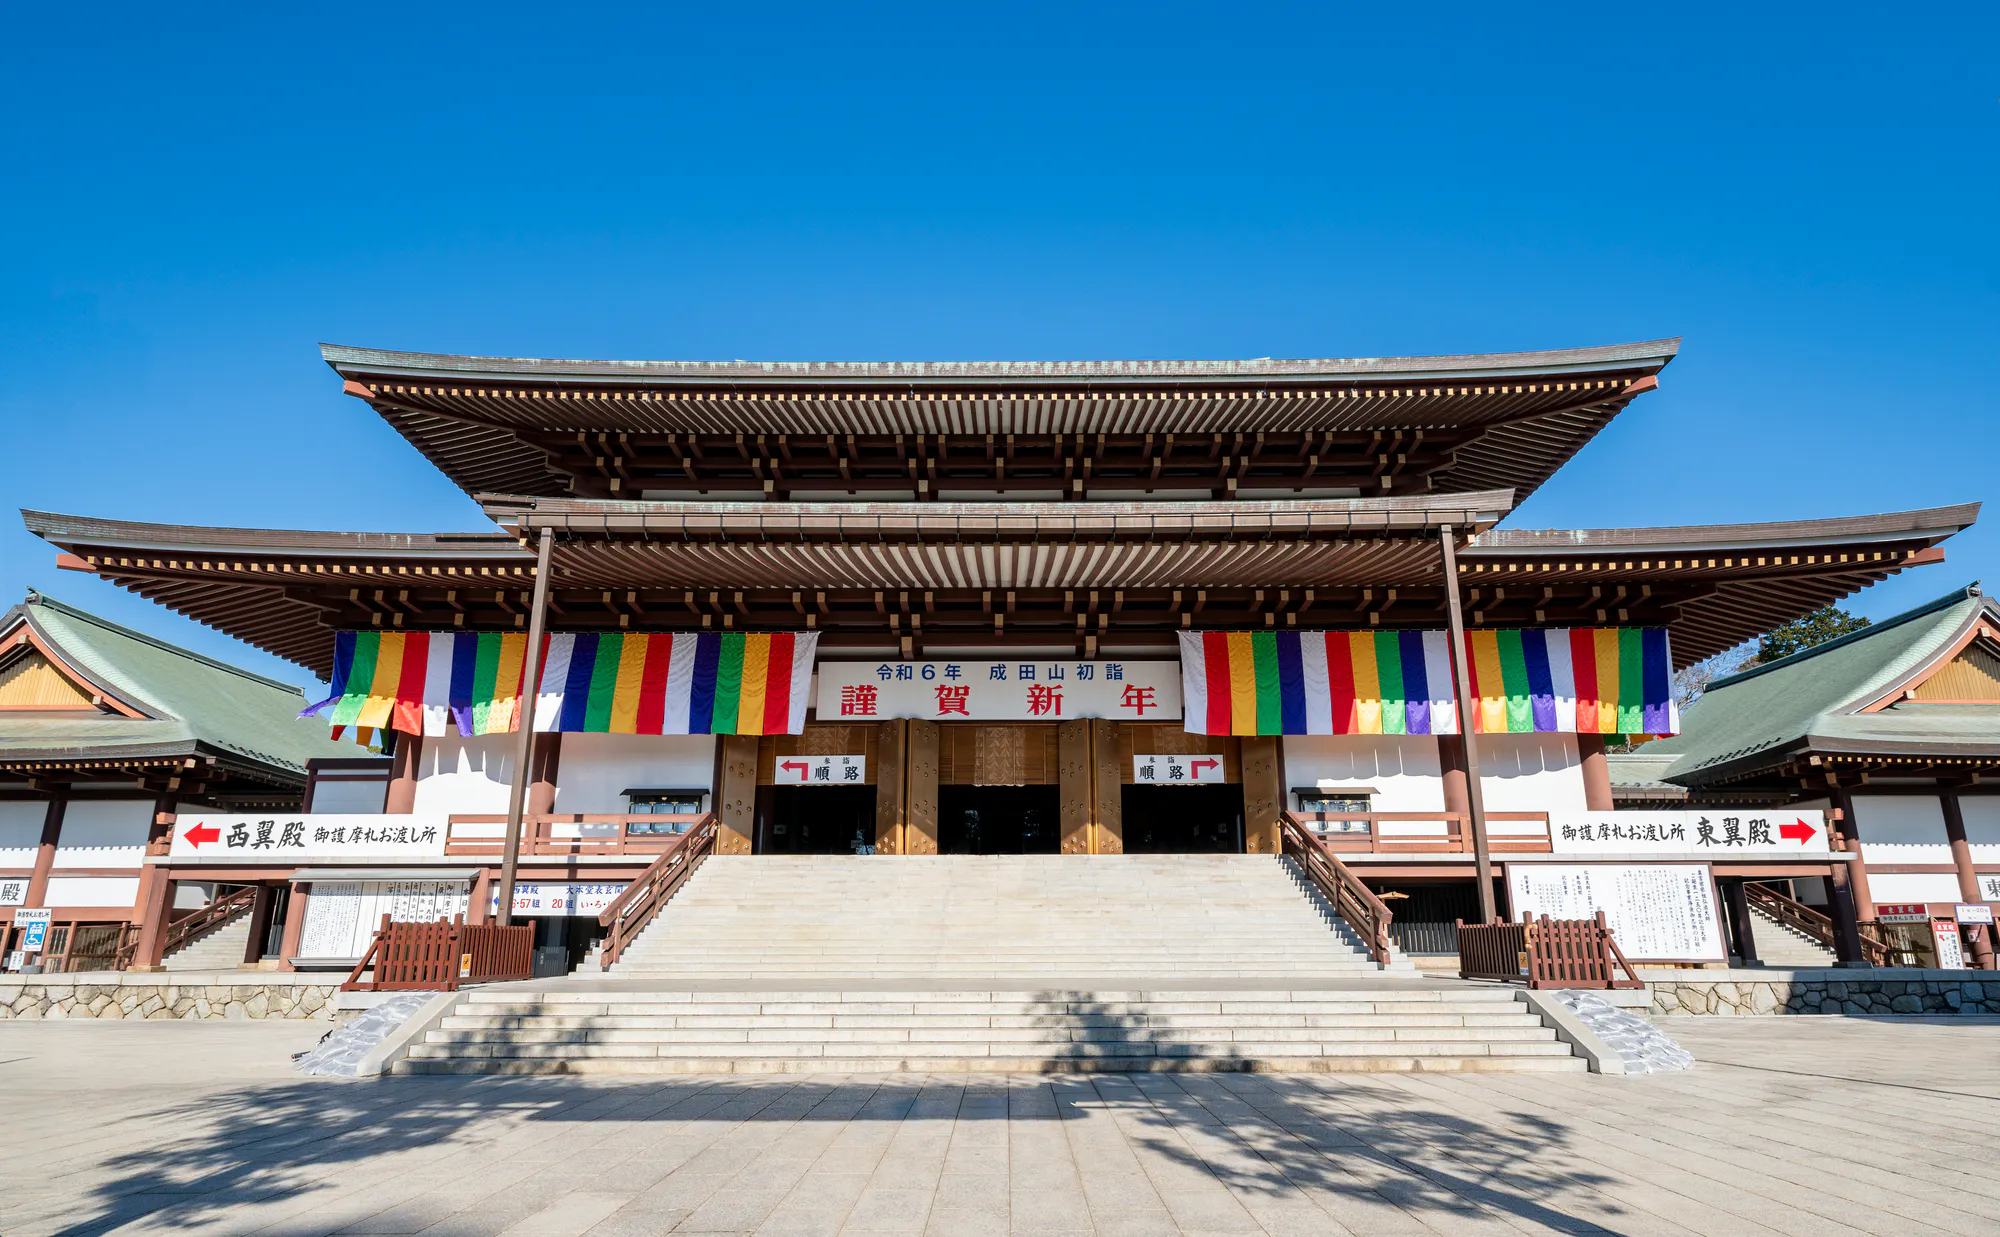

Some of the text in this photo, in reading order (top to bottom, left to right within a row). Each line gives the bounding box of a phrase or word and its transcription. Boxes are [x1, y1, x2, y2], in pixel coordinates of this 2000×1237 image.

[876, 664, 1124, 680] 令和6年 成田山初詣
[841, 684, 1157, 716] 謹賀新年
[814, 766, 859, 781] 順路
[1139, 765, 1184, 780] 順路
[226, 820, 437, 849] 西翼殿 御護摩札お渡し所
[1561, 817, 1776, 847] 御護摩札お渡し所 東翼殿
